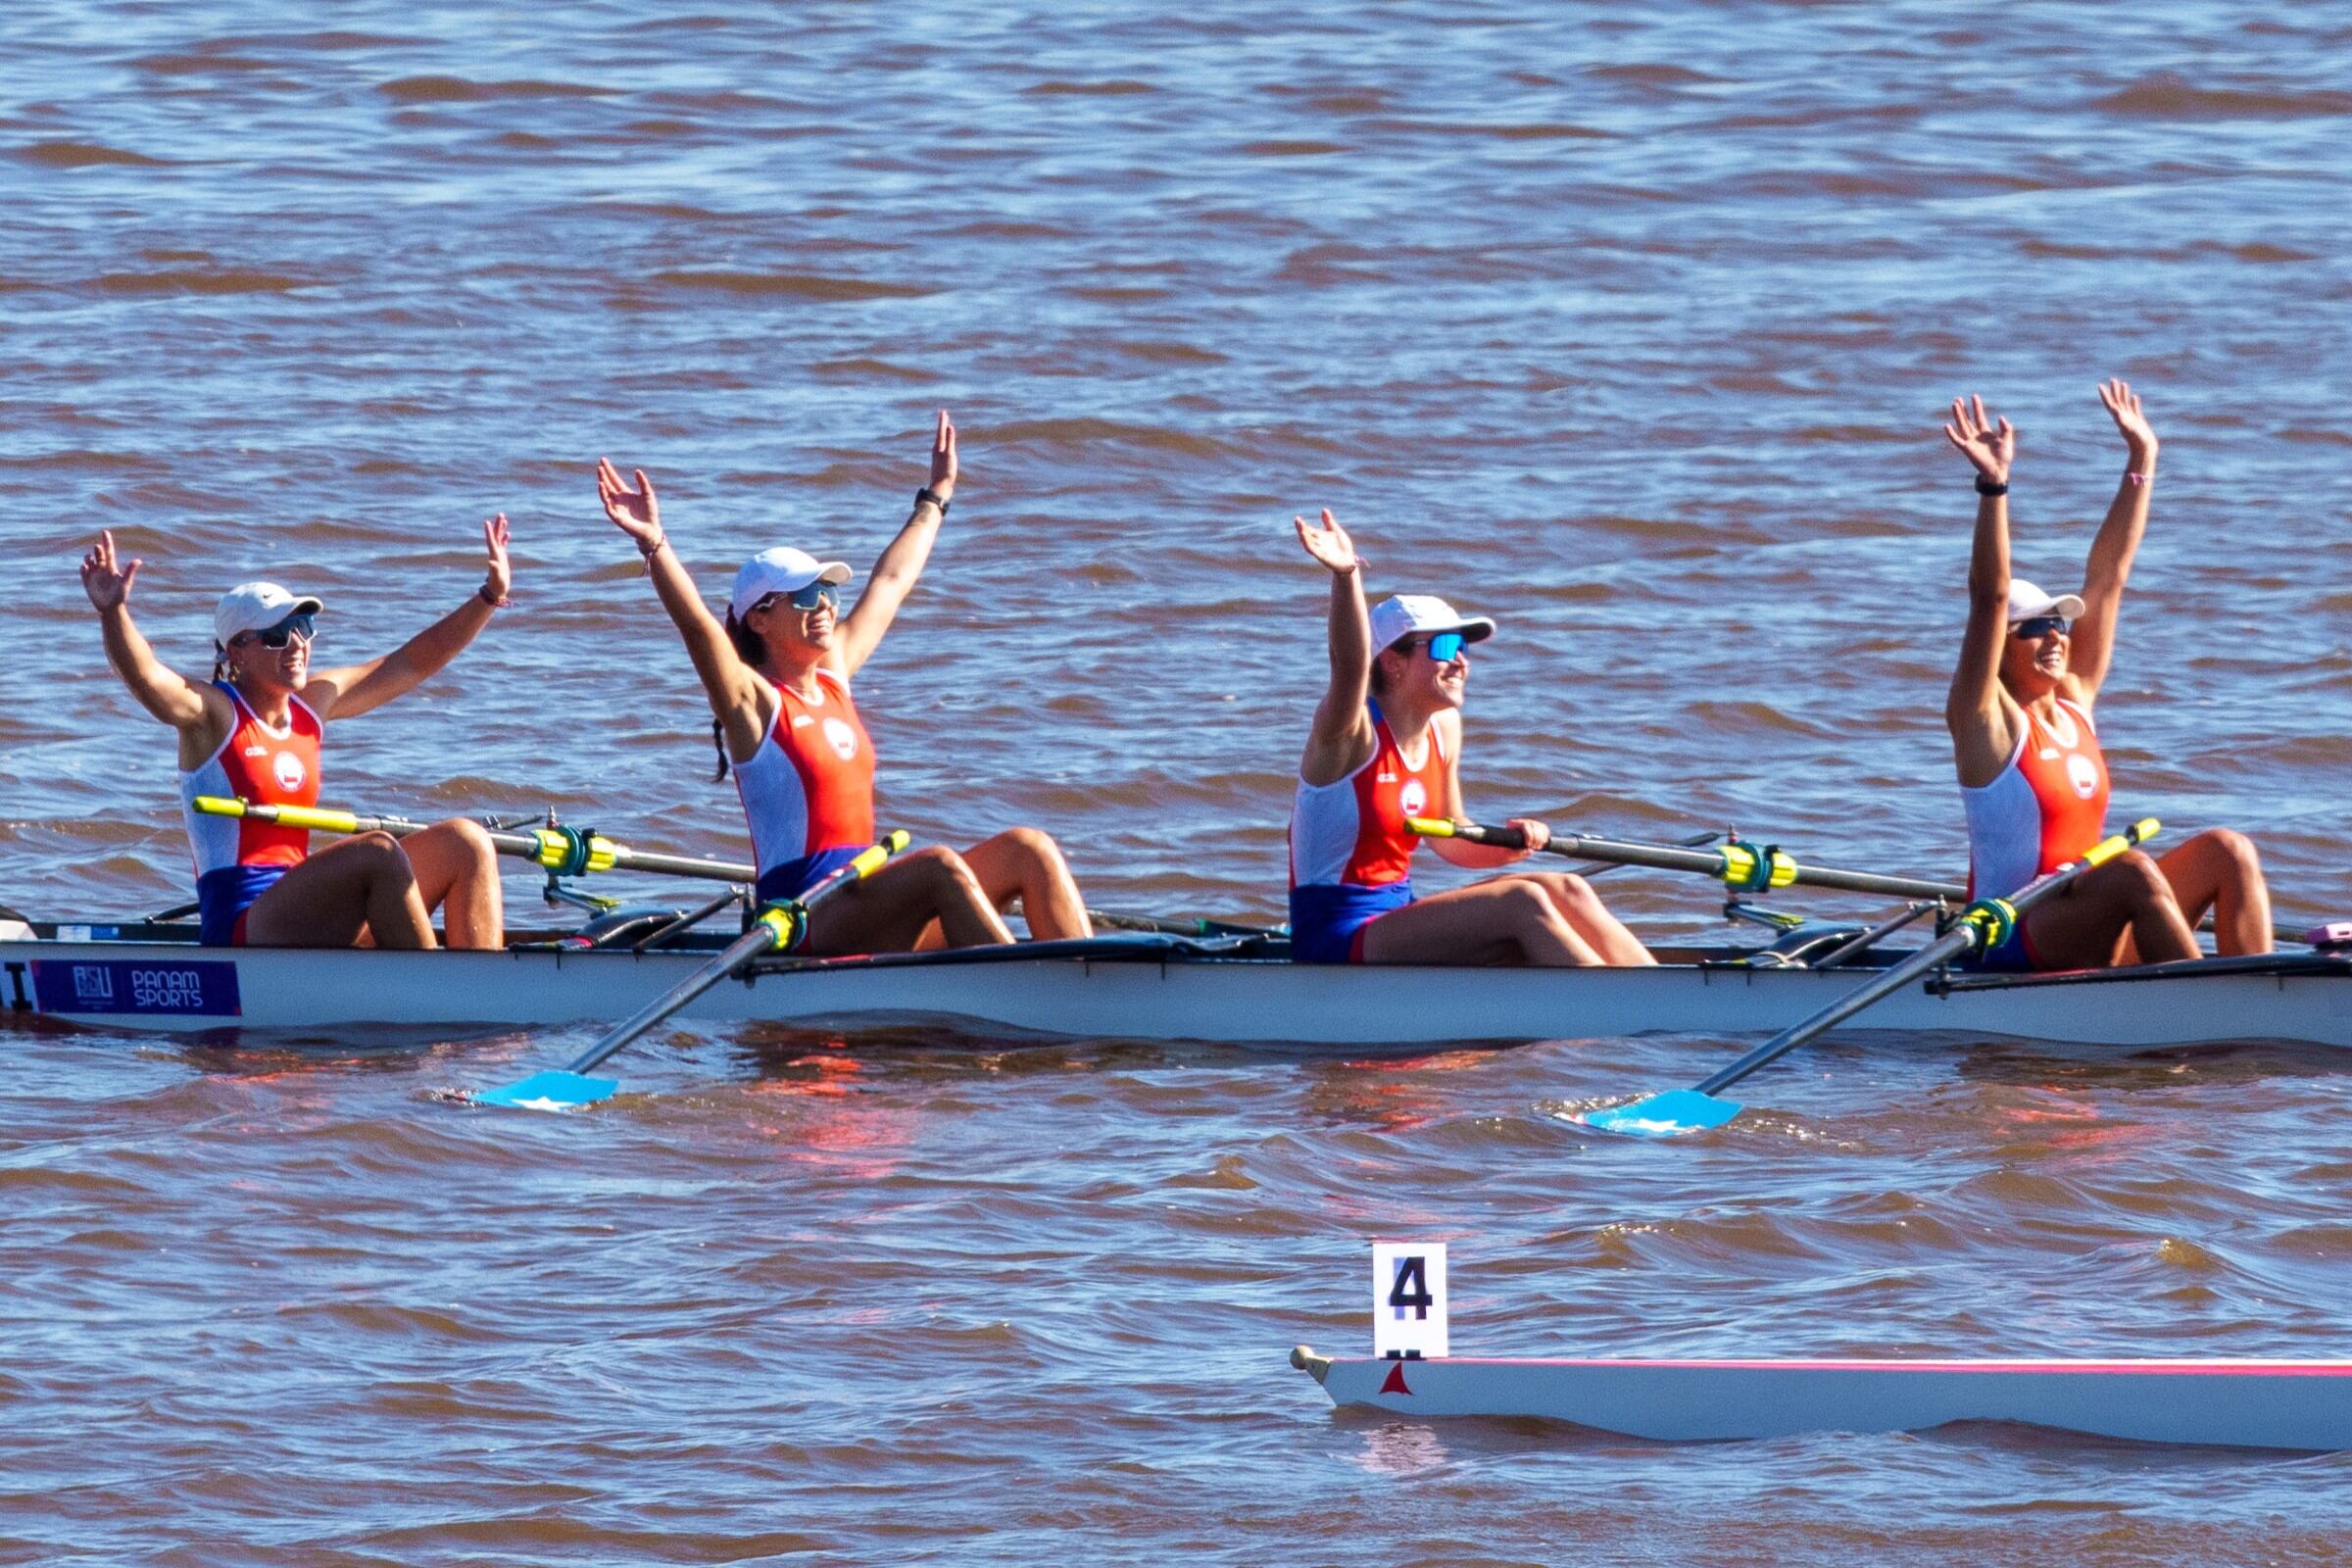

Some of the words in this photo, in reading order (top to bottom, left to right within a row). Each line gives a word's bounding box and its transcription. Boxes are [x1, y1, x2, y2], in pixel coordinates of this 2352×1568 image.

[131, 970, 200, 989] PANAM
[133, 989, 203, 1006] SPORTS
[1388, 1256, 1433, 1320] 4
